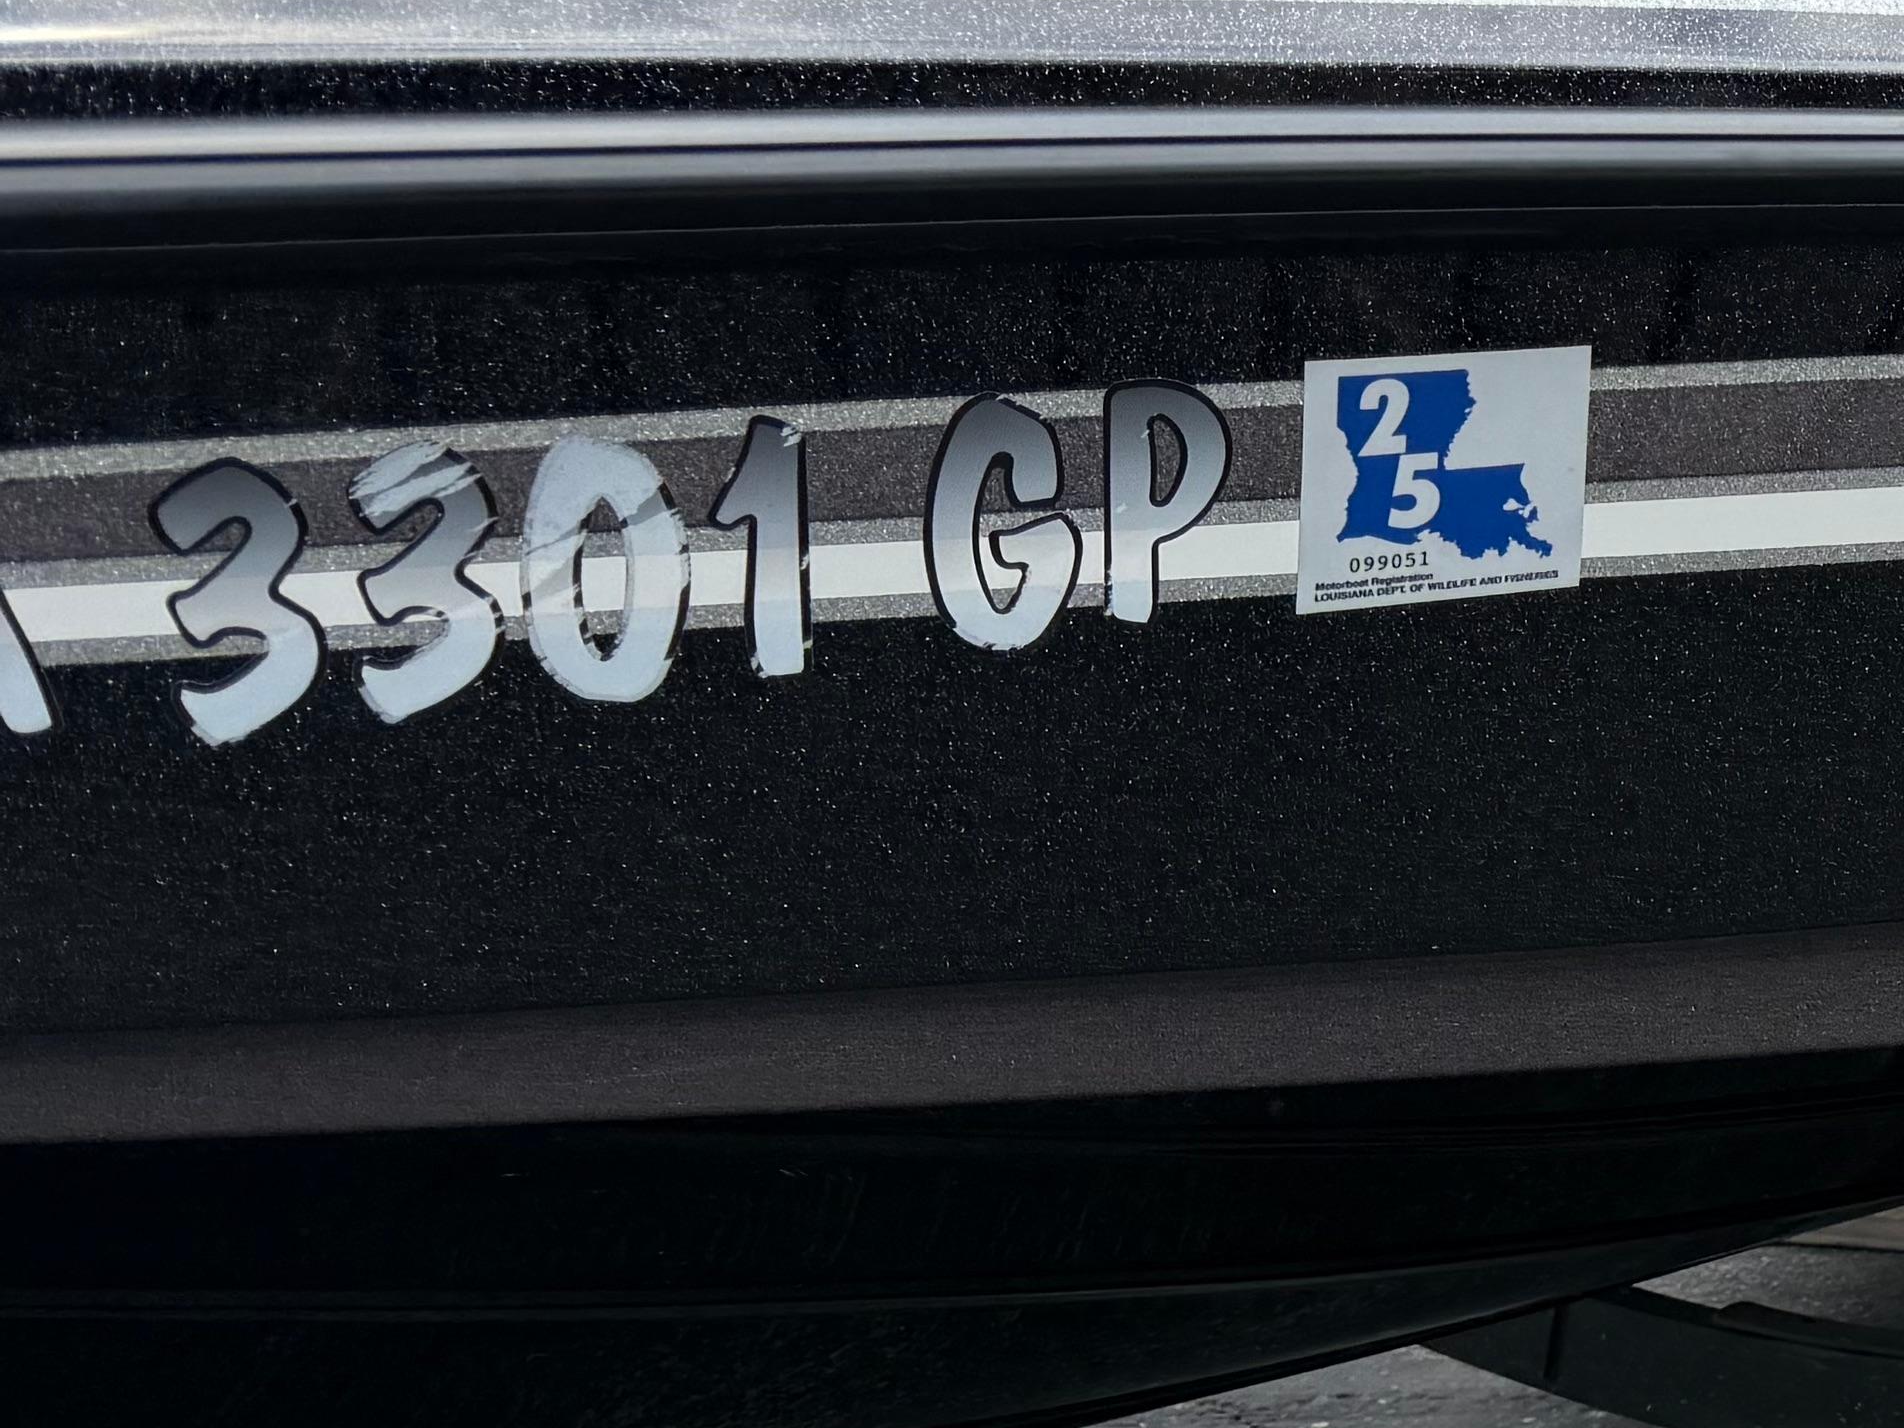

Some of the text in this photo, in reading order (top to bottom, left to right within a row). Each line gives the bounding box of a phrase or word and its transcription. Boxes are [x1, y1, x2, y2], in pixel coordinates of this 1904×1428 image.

[1357, 377, 1411, 458] 2
[1387, 451, 1441, 530] 5
[148, 415, 812, 747] 3301
[923, 378, 1233, 653] GP
[1314, 573, 1434, 592] Motorboat Registration
[1349, 551, 1430, 573] 099051
[1314, 589, 1375, 603] LOUISIANA
[1409, 583, 1424, 593] OF
[1427, 578, 1478, 591] WILDLIFE
[1479, 575, 1503, 586] AND
